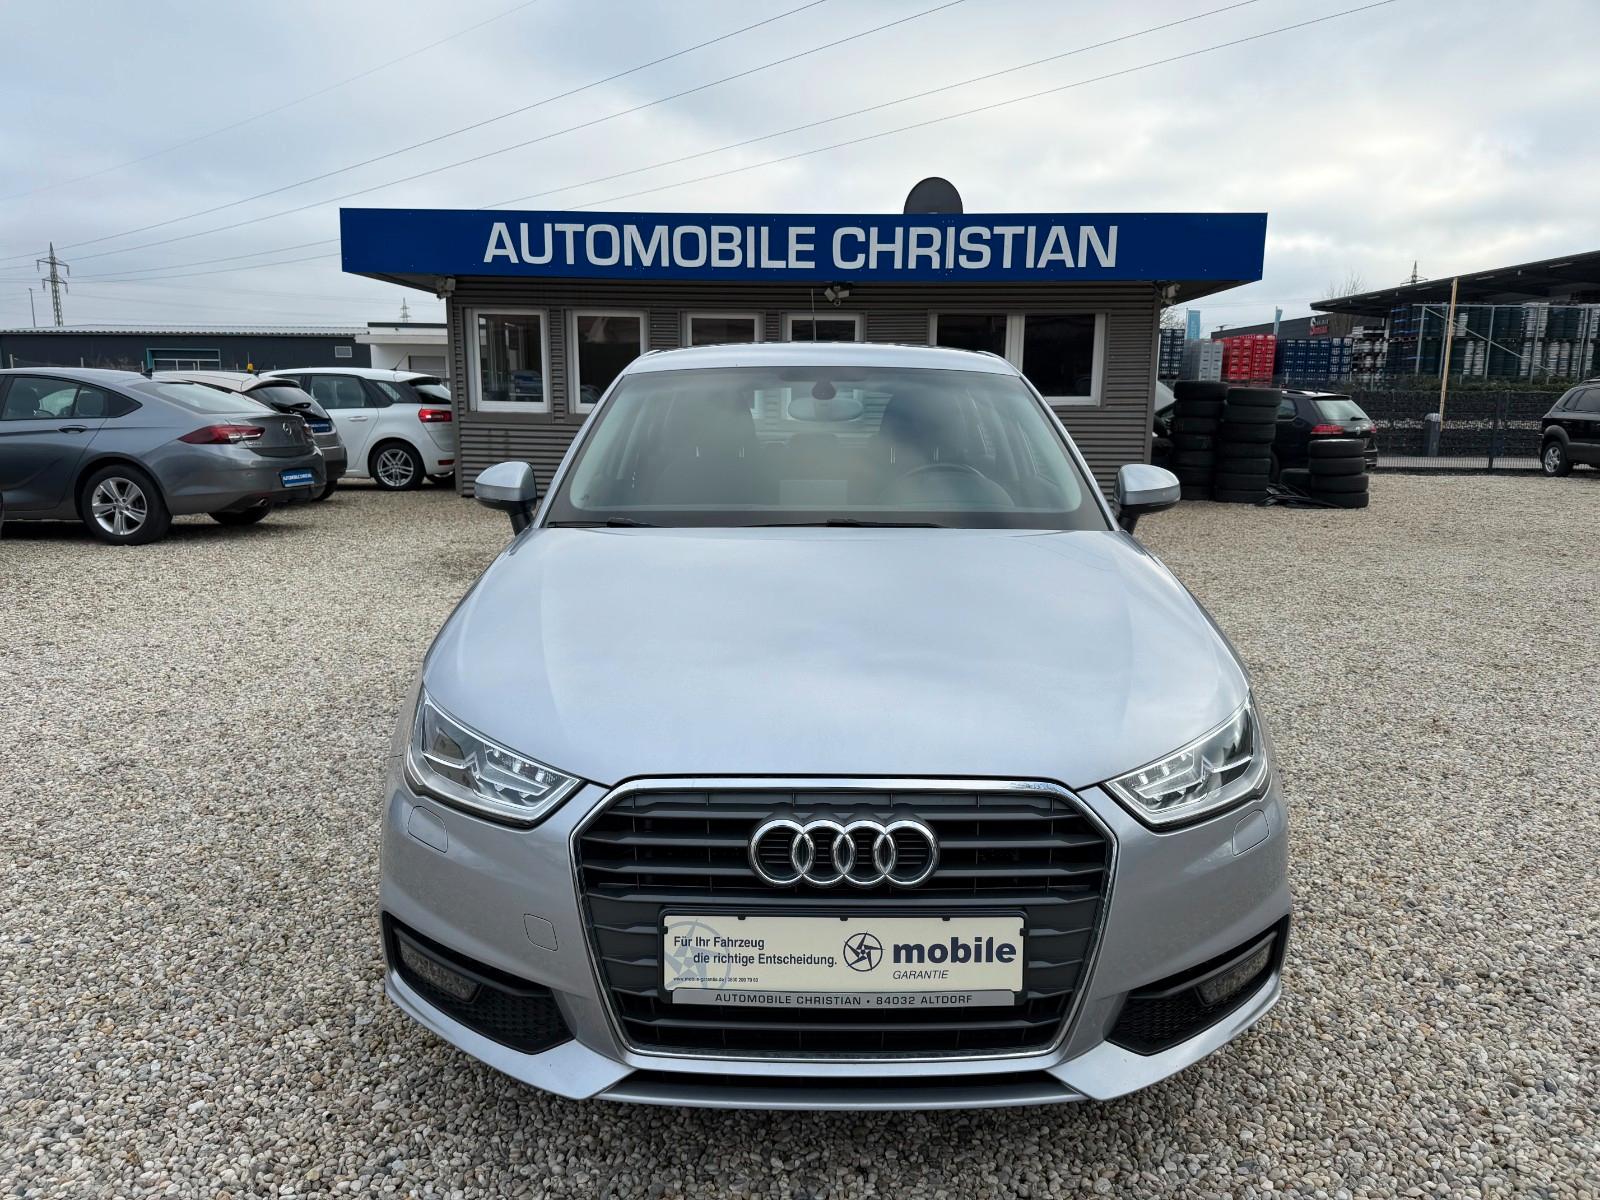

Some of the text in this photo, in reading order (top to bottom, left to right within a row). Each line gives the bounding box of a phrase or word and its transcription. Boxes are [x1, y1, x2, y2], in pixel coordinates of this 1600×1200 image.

[482, 222, 1118, 270] AUTOMOBILE CHRISTIAN
[674, 936, 765, 949] Für Ihr Fahrzeug
[893, 937, 1017, 964] mobile
[693, 952, 838, 968] die richtige Entscheidung.
[892, 970, 950, 980] GARANTIE
[715, 993, 973, 1005] AUTOMOBILE CHRISTIAN 84032 ALTDORF
